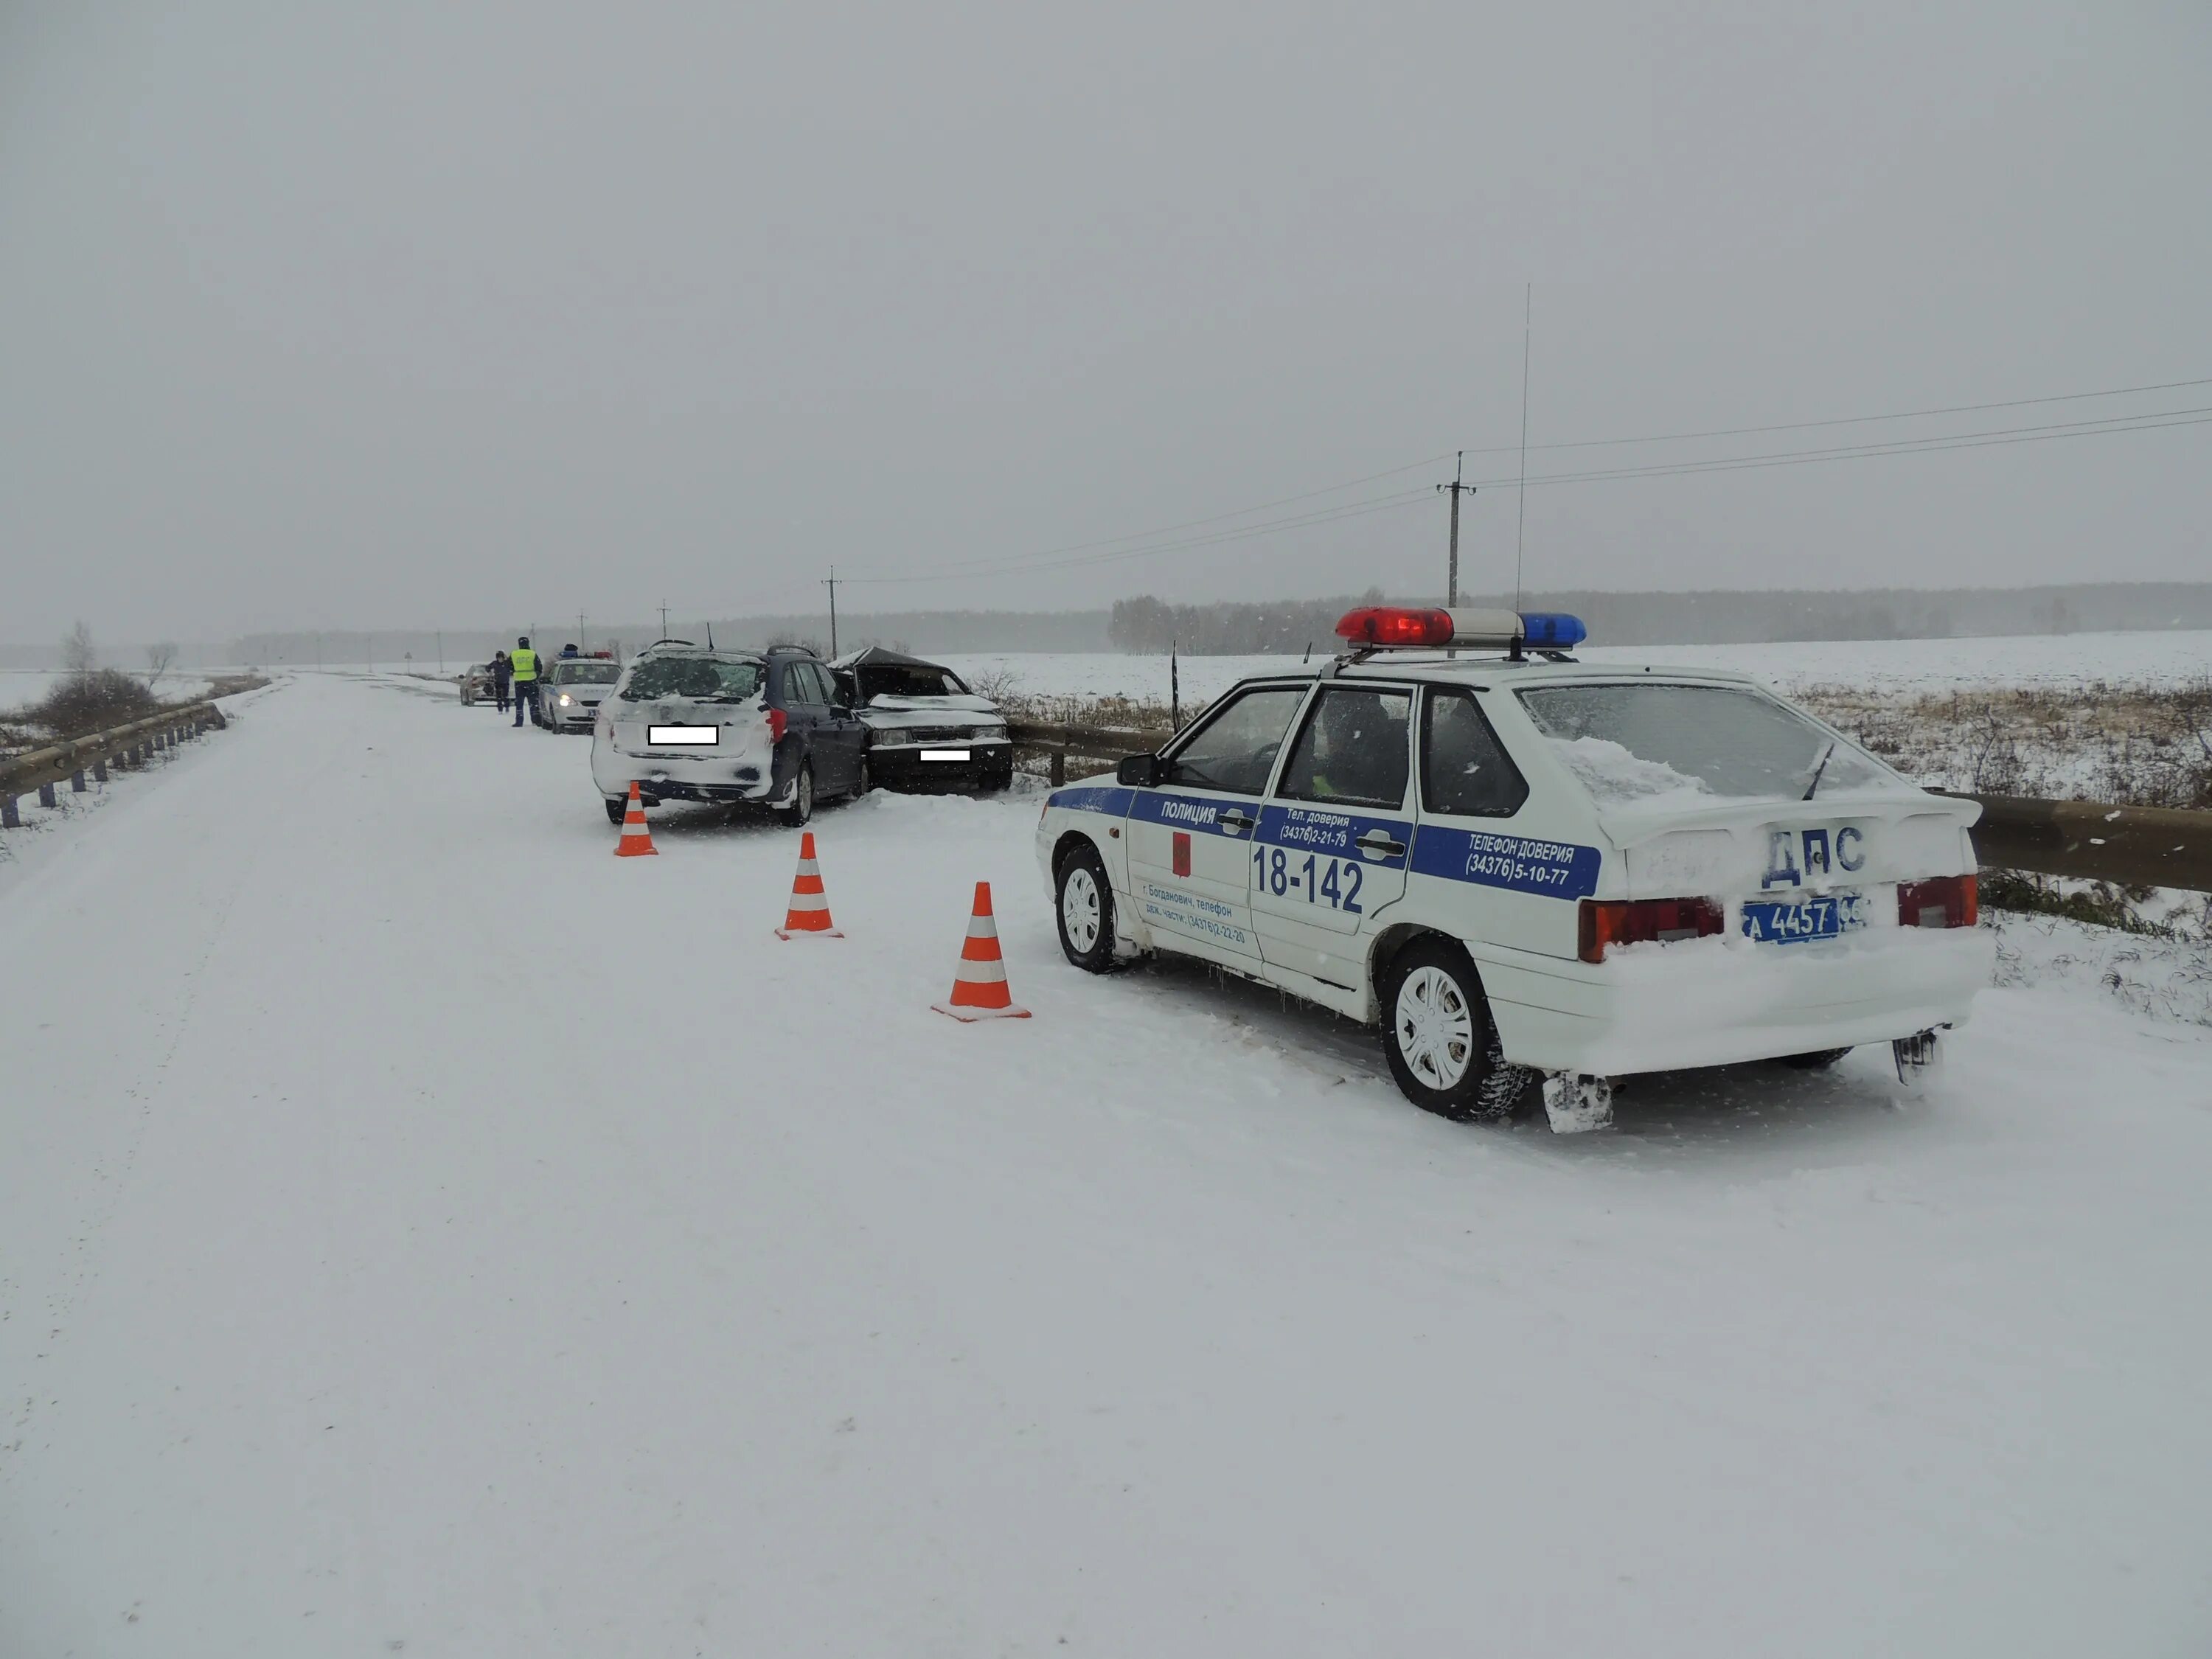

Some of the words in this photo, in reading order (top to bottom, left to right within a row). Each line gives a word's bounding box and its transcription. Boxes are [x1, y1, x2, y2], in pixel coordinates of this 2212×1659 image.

[1161, 801, 1217, 826] ПОЛИЦИЯ
[1287, 808, 1304, 821] Тел.
[1307, 812, 1350, 827] доверия
[1280, 824, 1347, 847] (34376)2-21-79
[1469, 834, 1517, 855] ТЕЛЕФОН
[1517, 841, 1575, 864] ДОВЕРИЯ
[1465, 853, 1570, 886] (34376)5-10-77
[1761, 827, 1866, 889] ДПС
[1253, 845, 1363, 914] 18-142
[1149, 884, 1195, 909] Богданович,
[1196, 898, 1233, 918] телефон
[1163, 908, 1186, 924] части:
[1187, 915, 1245, 944] (34376)2-22-20
